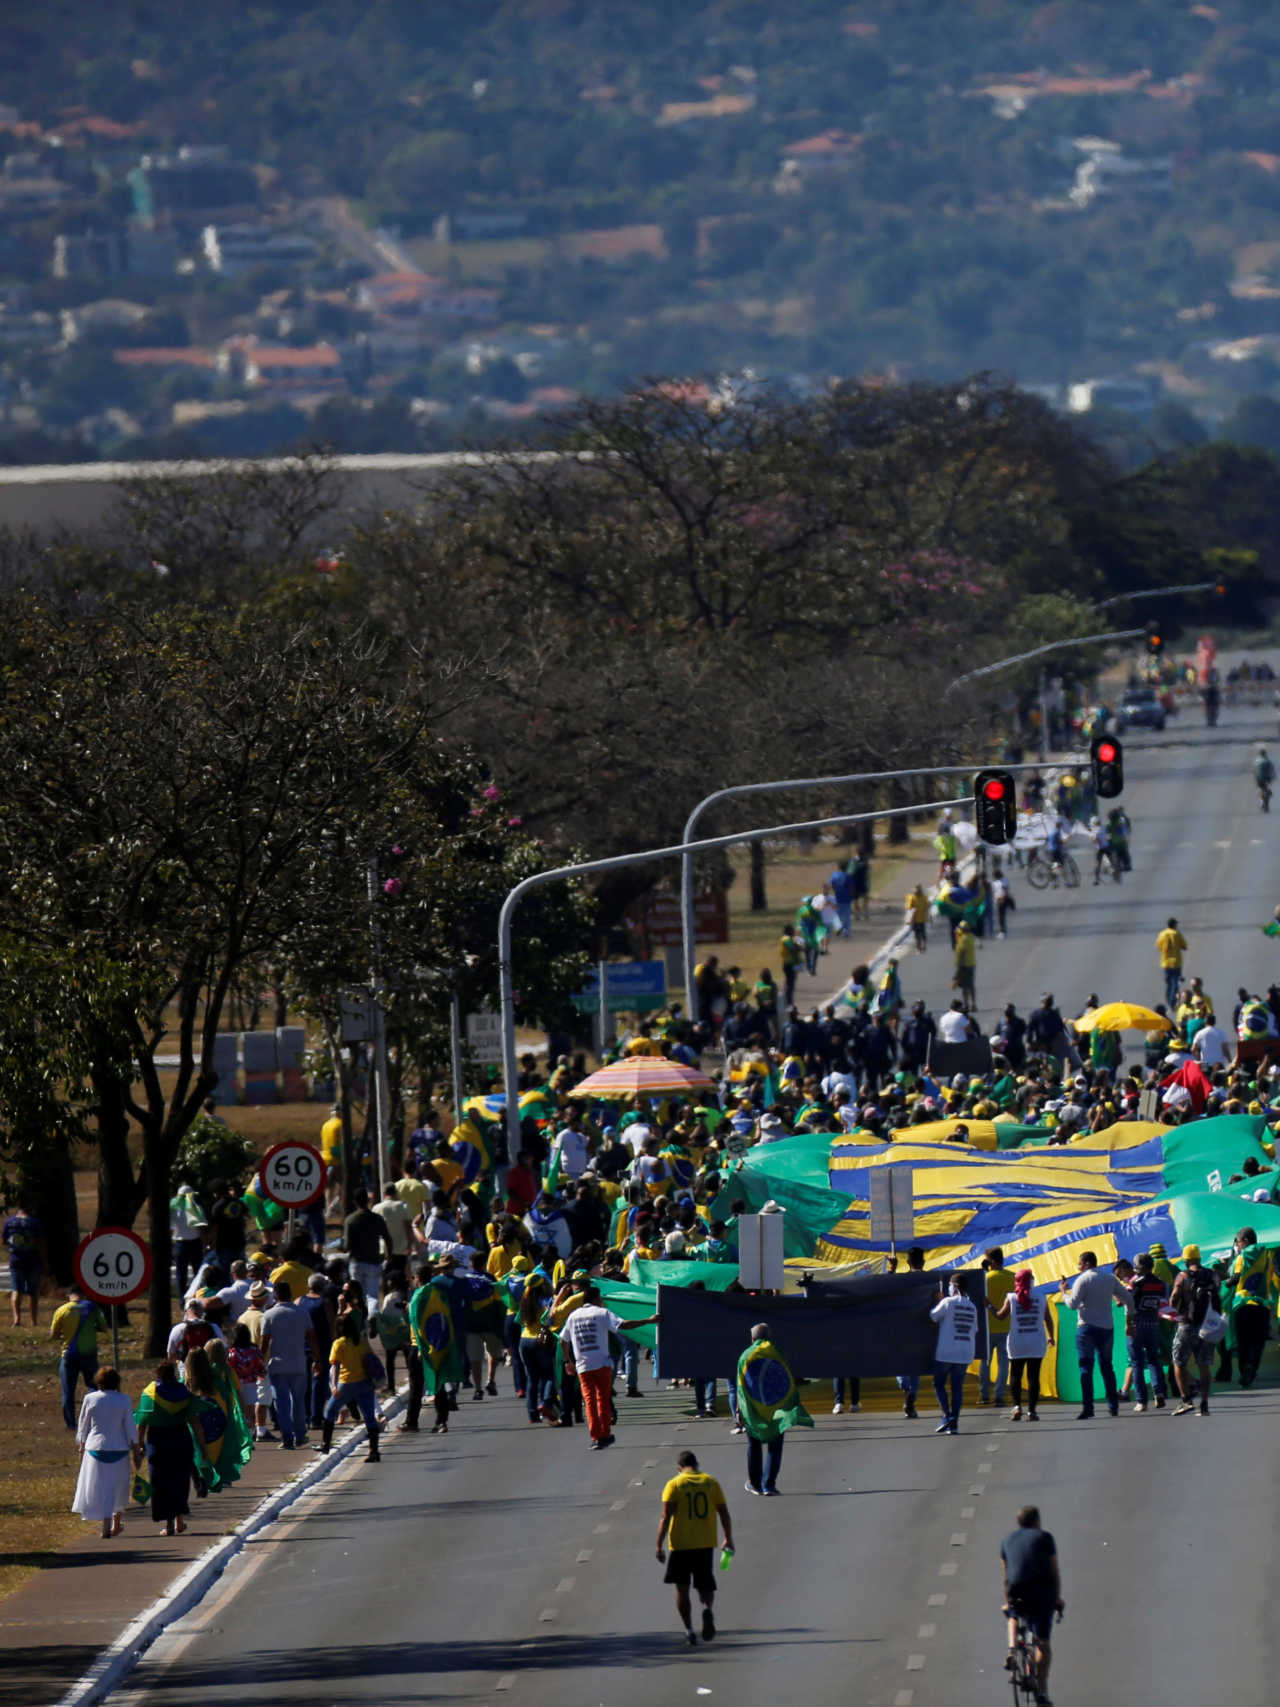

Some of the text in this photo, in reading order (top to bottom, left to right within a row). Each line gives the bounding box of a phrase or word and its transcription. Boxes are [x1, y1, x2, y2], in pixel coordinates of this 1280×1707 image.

[275, 1155, 313, 1177] 60
[273, 1178, 313, 1192] km/h
[93, 1251, 134, 1278] 60
[98, 1281, 128, 1290] km/h
[685, 1491, 708, 1520] 10
